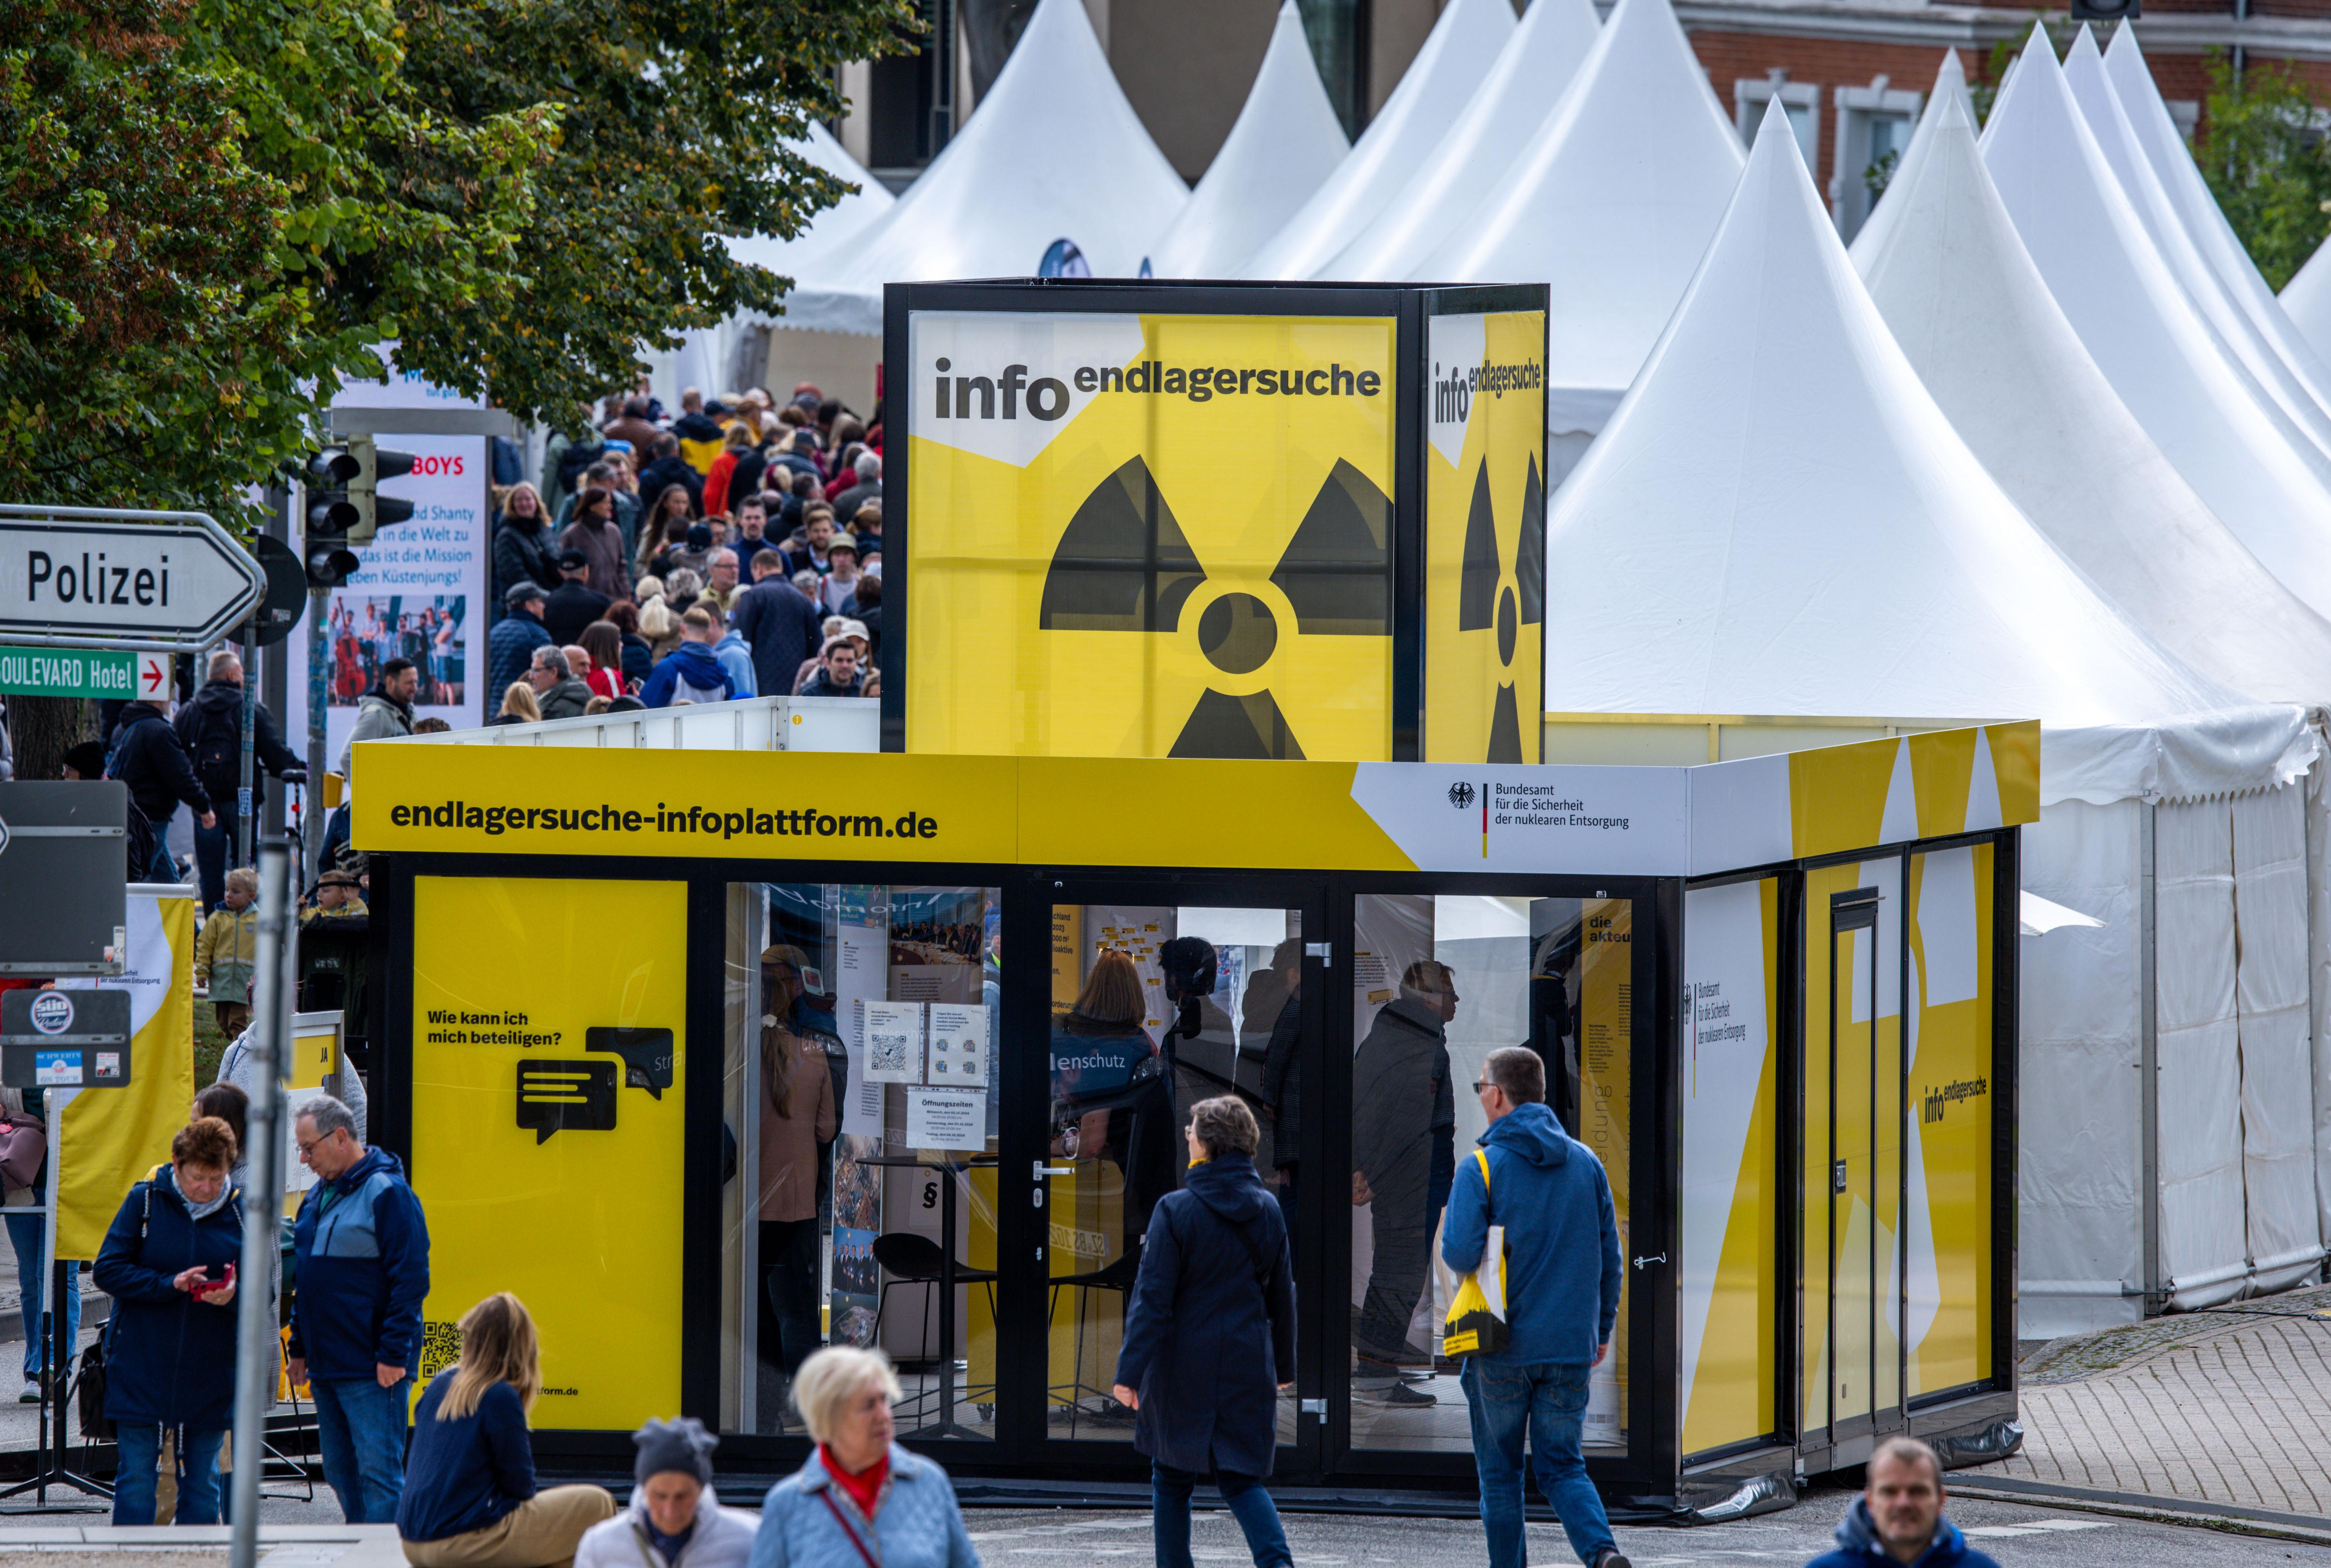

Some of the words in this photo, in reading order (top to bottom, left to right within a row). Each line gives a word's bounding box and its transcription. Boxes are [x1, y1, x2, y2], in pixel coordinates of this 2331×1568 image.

[935, 357, 1070, 422] info
[1074, 360, 1381, 402] endlagersuche
[1434, 361, 1468, 424] info
[1469, 357, 1541, 400] endlagersuche
[413, 506, 427, 520] nd
[431, 505, 474, 523] Shanty
[384, 526, 395, 541] in
[399, 526, 417, 541] die
[421, 526, 450, 541] Welt
[454, 530, 469, 542] zu
[359, 549, 380, 562] das
[384, 549, 398, 563] ist
[402, 549, 421, 563] die
[424, 548, 472, 562] Mission
[29, 551, 169, 607] Polizei
[350, 571, 377, 583] eben
[382, 568, 462, 587] Küstenjungs!
[0, 656, 82, 687] OULEVARD
[91, 660, 132, 689] Hotel
[1496, 783, 1554, 796] Bundesamt
[1495, 798, 1510, 810] für
[1513, 799, 1528, 810] die
[1532, 800, 1584, 811] Sicherheit
[390, 801, 938, 839] endlagersuche-infoplattform.de
[1495, 814, 1512, 825] der
[1515, 814, 1566, 826] nuklearen
[1570, 815, 1629, 830] Entsorgung
[1053, 924, 1064, 932] 2023
[1590, 915, 1612, 929] die
[1589, 930, 1631, 943] akteu
[1699, 981, 1720, 999] Bundesamt
[37, 999, 68, 1012] SÜD
[1711, 1000, 1730, 1019] Sicherheit
[428, 1010, 456, 1024] Wie
[460, 1011, 500, 1025] kann
[504, 1011, 528, 1025] ich
[428, 1029, 467, 1044] mich
[470, 1030, 562, 1047] beteiligen?
[1705, 1025, 1723, 1043] nuklearen
[1724, 1023, 1746, 1042] Entsorgung
[321, 1047, 328, 1063] JA
[1050, 1052, 1126, 1071] lenschutz
[922, 1099, 973, 1108] Öffnungszeiten
[1925, 1085, 1944, 1124] info
[1944, 1075, 1986, 1104] endlagersuche
